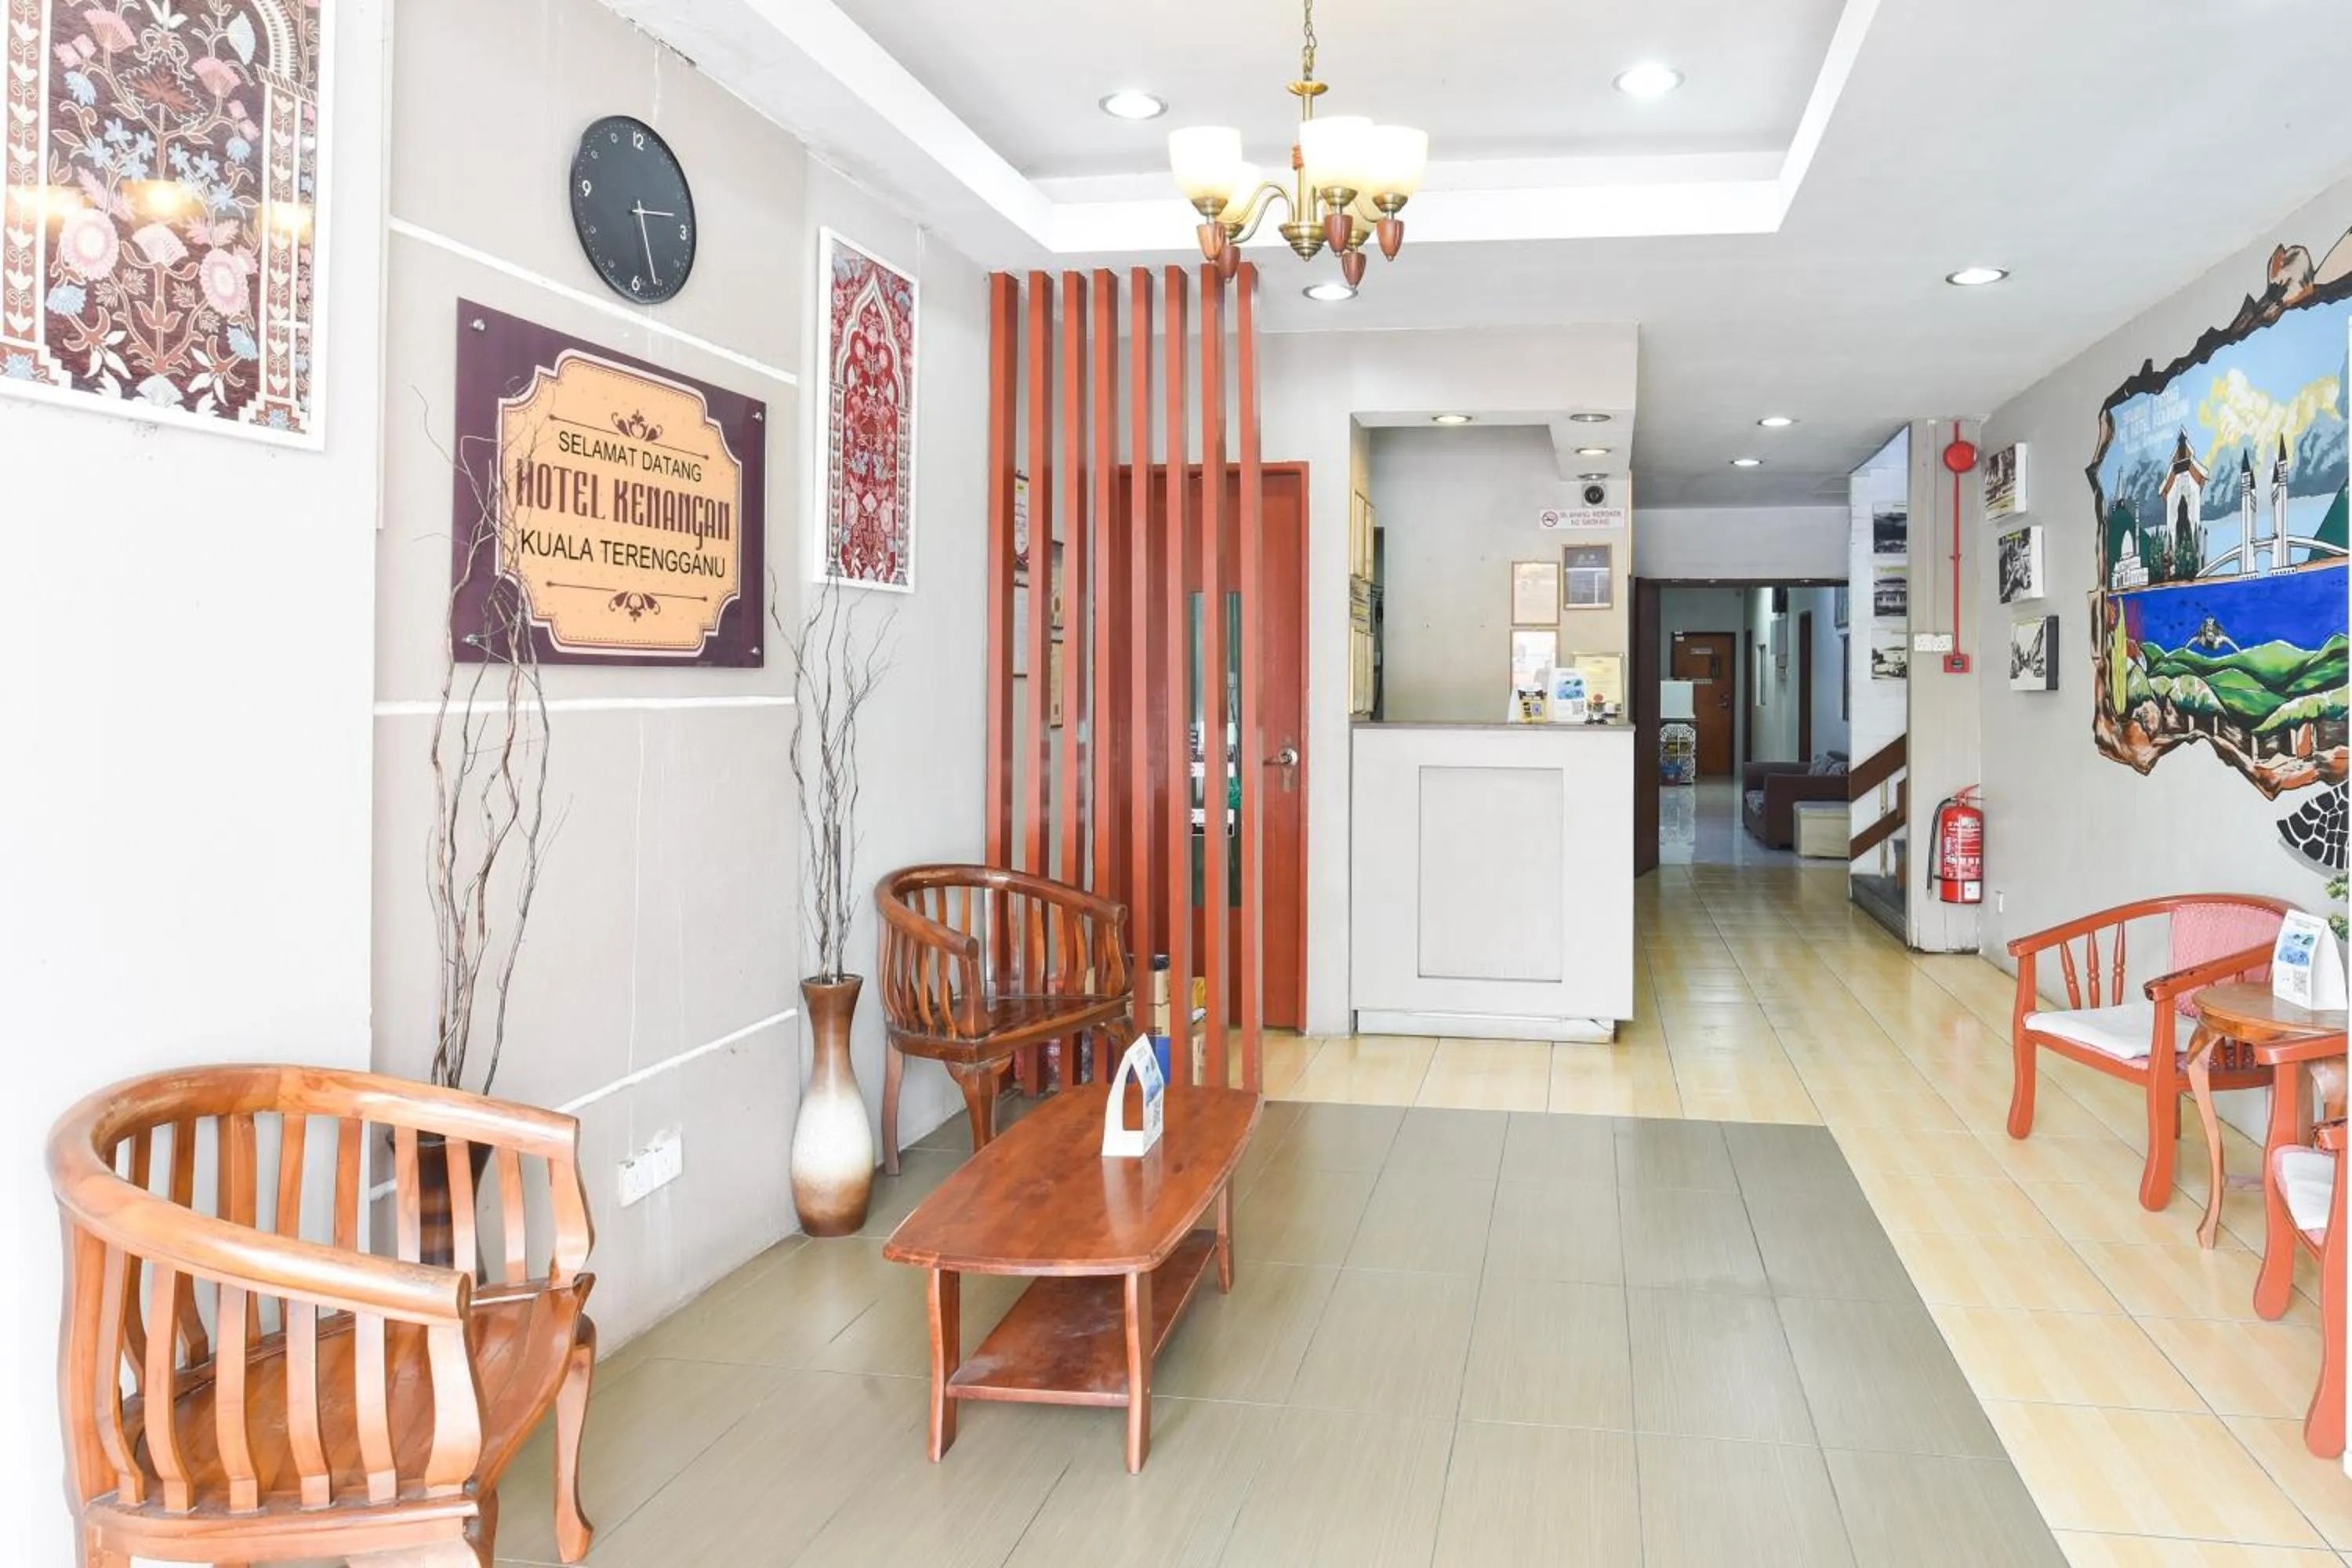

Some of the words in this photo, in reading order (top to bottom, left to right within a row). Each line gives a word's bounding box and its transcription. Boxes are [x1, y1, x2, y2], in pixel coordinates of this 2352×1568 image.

[632, 131, 644, 151] 12
[582, 180, 592, 197] 9
[679, 224, 688, 241] 3
[631, 275, 641, 292] 6
[558, 430, 637, 468] SELAMAT
[642, 451, 702, 482] DATANG
[517, 458, 606, 520] HOTEL
[613, 477, 731, 550] KENANGAN
[521, 528, 593, 562] KUALA
[600, 539, 725, 579] TERENGGANU
